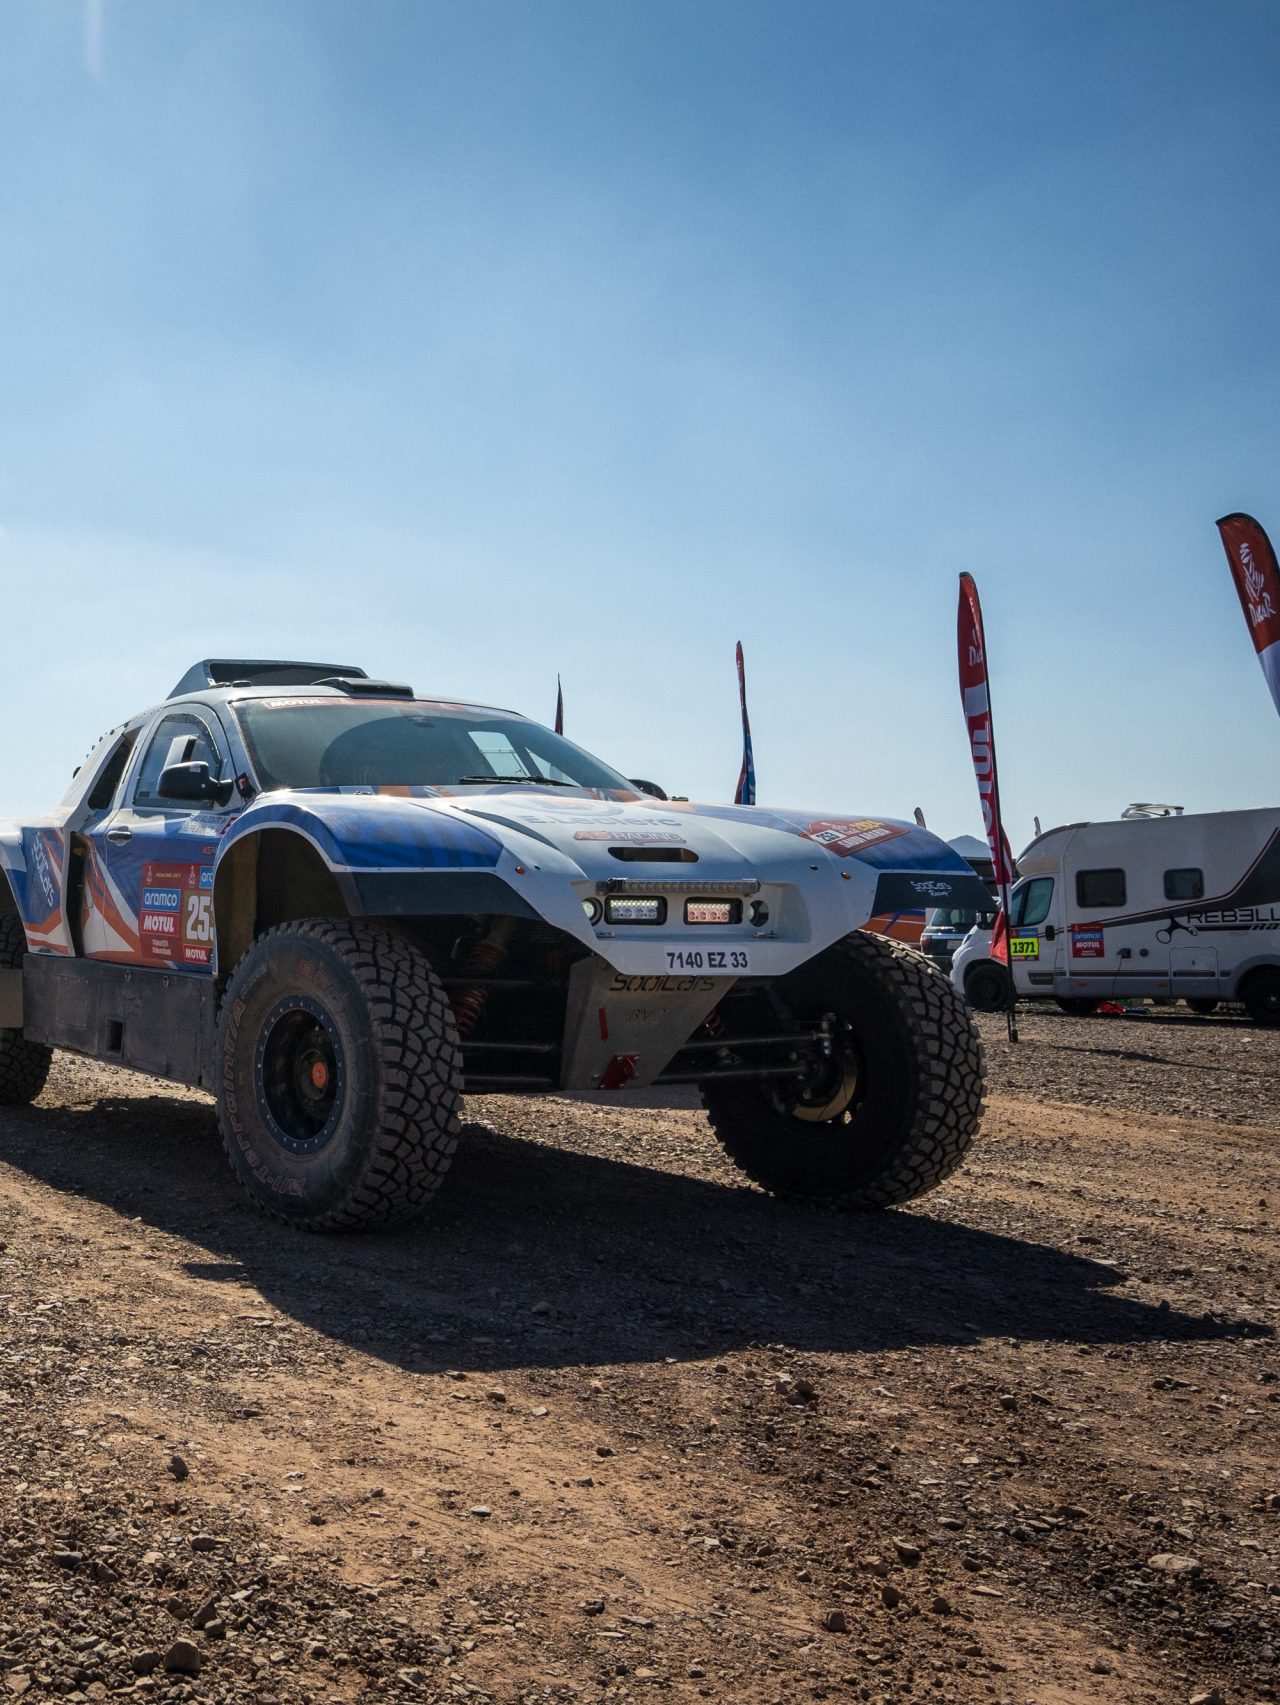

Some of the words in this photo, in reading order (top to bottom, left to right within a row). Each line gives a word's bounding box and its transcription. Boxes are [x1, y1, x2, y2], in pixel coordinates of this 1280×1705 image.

[144, 892, 178, 907] aramco
[143, 915, 175, 933] MOTUL
[185, 948, 208, 961] MOTUL
[1012, 941, 1036, 954] 1371
[666, 952, 703, 969] 7140
[708, 952, 727, 968] EZ
[731, 952, 748, 968] 33
